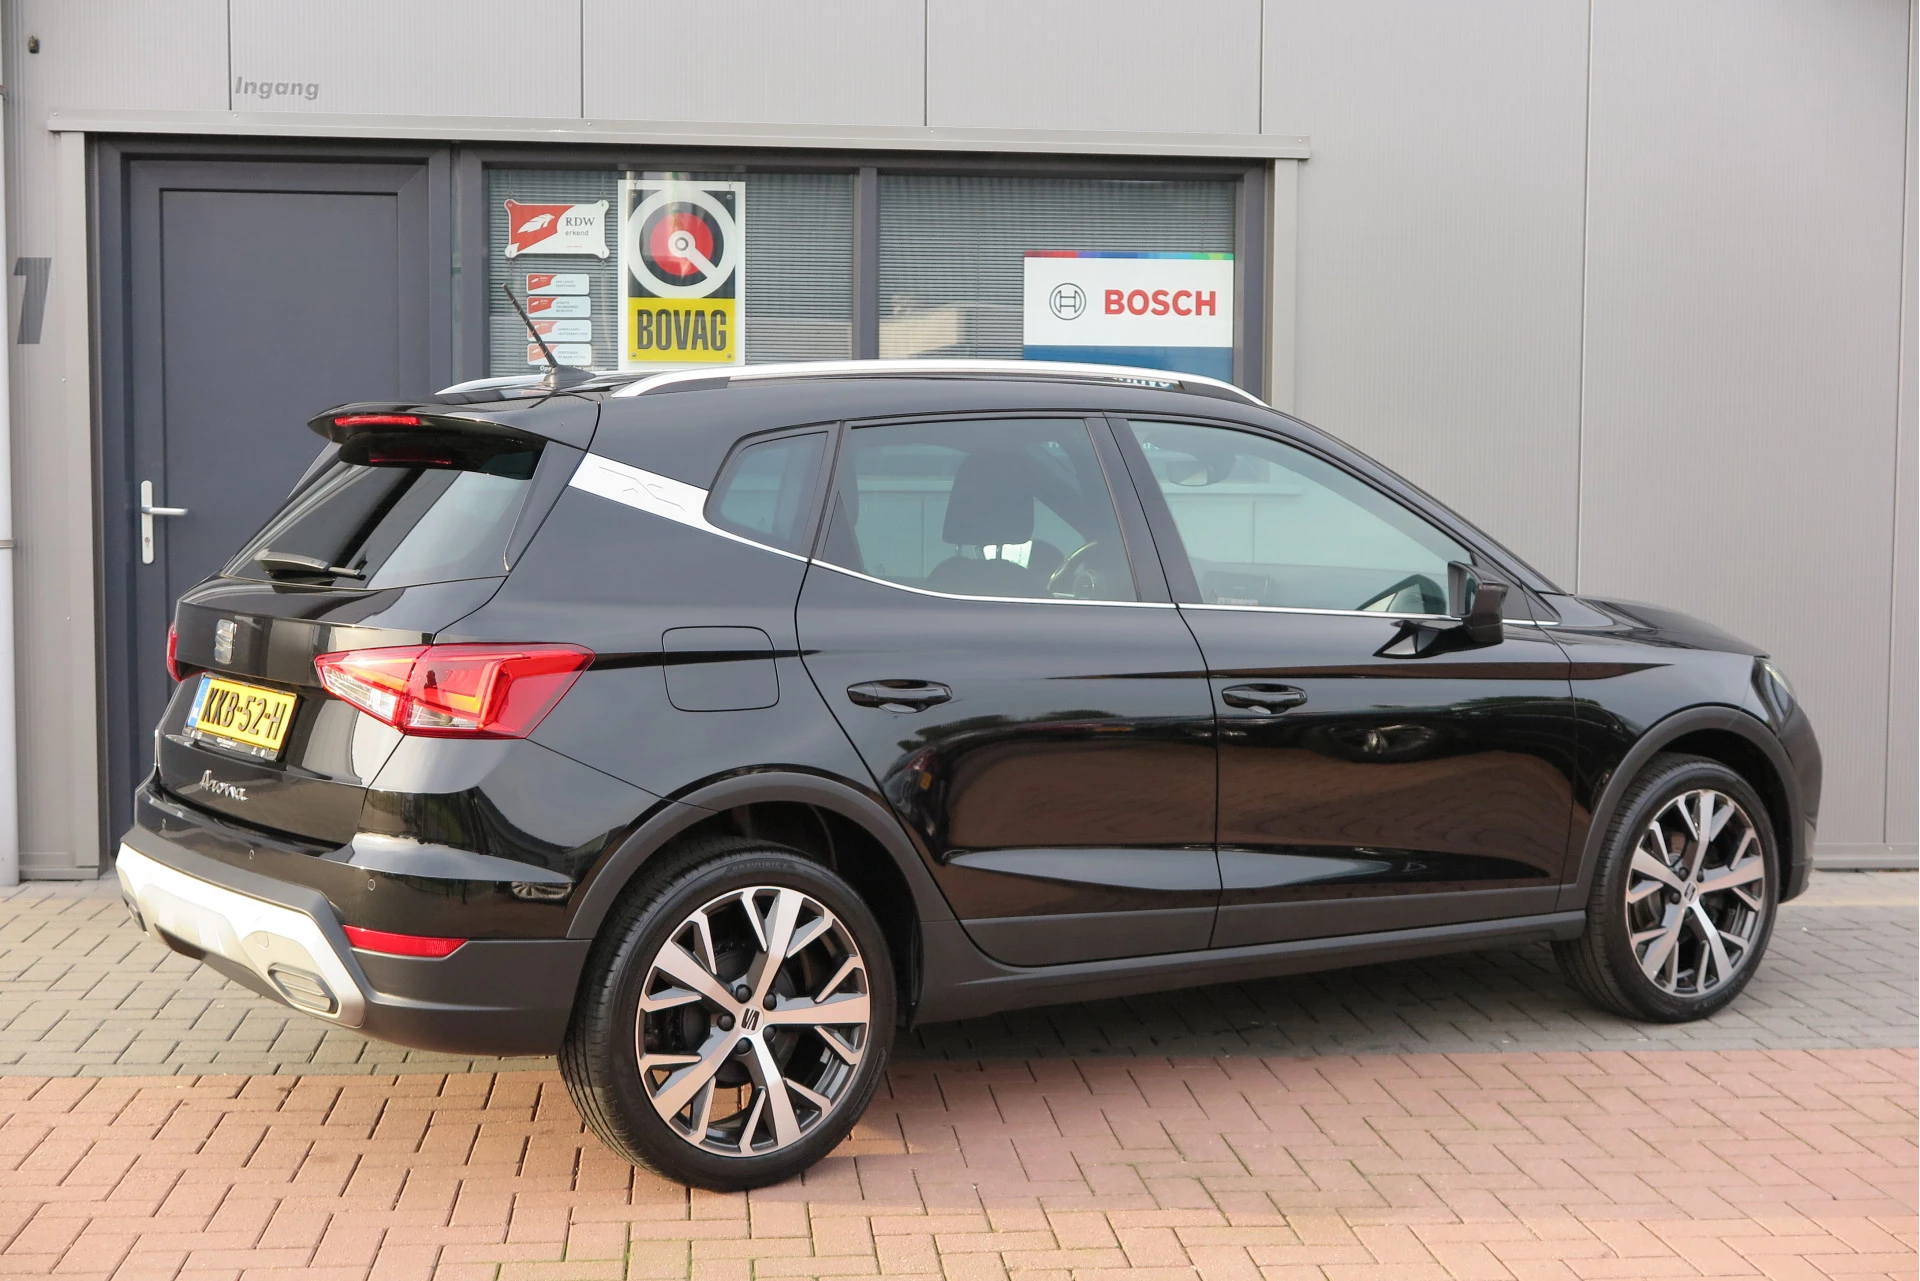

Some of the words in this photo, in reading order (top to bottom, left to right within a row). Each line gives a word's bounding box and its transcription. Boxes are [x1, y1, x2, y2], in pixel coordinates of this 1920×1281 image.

[235, 76, 320, 100] Ingang
[565, 216, 596, 227] RDW
[13, 257, 52, 345] 1
[1104, 289, 1216, 316] BOSCH
[636, 308, 727, 351] BOVAG
[201, 687, 287, 741] KKB-52-H
[200, 769, 248, 801] Arona
